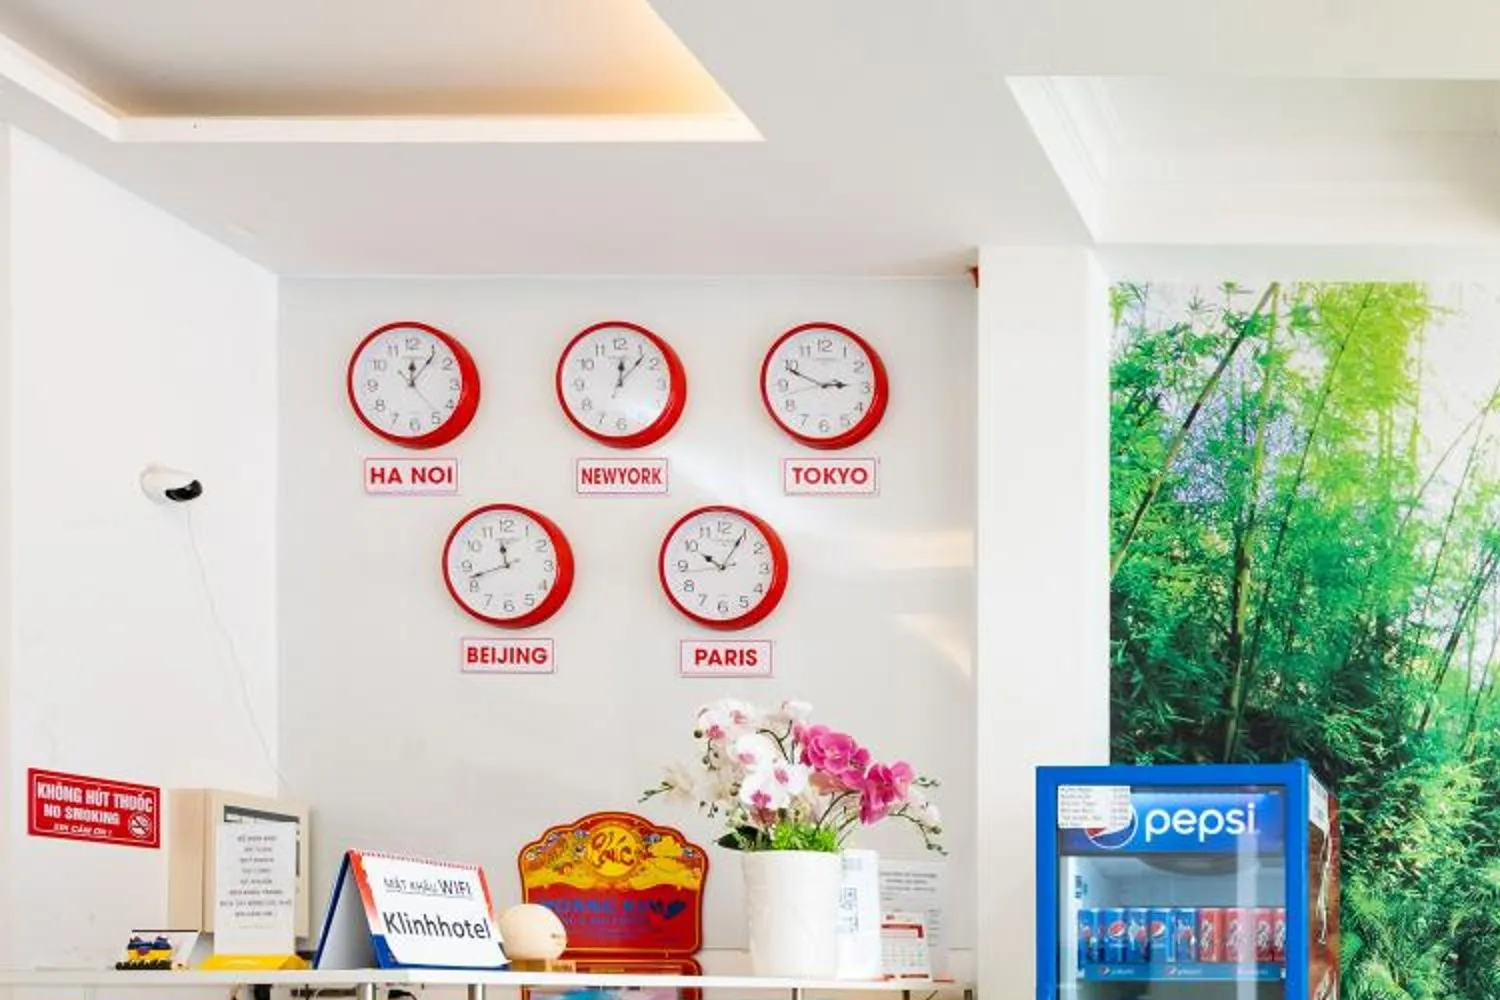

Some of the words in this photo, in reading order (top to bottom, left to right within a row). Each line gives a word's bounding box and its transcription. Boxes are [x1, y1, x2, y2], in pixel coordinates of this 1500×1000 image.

[404, 338, 421, 350] 12
[594, 344, 606, 356] 11
[613, 338, 628, 350] 12
[817, 339, 833, 352] 12
[388, 345, 400, 357] 11
[800, 345, 812, 358] 11
[373, 360, 387, 371] 10
[442, 358, 453, 370] 2
[580, 358, 595, 371] 10
[648, 358, 660, 370] 2
[853, 360, 865, 373] 2
[367, 379, 378, 392] 9
[449, 379, 460, 392] 3
[573, 379, 585, 392] 9
[778, 379, 789, 392] 9
[862, 382, 871, 394] 3
[374, 399, 385, 412] 8
[581, 398, 593, 411] 8
[784, 400, 796, 412] 8
[854, 402, 864, 413] 4
[389, 413, 399, 426] 7
[431, 412, 441, 424] 5
[616, 418, 628, 431] 6
[799, 414, 810, 426] 7
[840, 414, 851, 426] 5
[409, 419, 421, 432] 6
[818, 420, 830, 433] 6
[370, 466, 402, 484] HA
[411, 466, 453, 484] NOI
[581, 467, 663, 485] NEWYORK
[792, 467, 868, 485] TOKYO
[482, 526, 494, 538] 11
[499, 520, 514, 532] 12
[699, 526, 712, 538] 11
[717, 521, 733, 534] 12
[467, 540, 483, 553] 10
[535, 540, 548, 552] 2
[684, 540, 699, 553] 10
[753, 541, 765, 555] 2
[461, 560, 472, 573] 9
[544, 560, 554, 572] 3
[677, 560, 689, 573] 9
[758, 562, 770, 575] 3
[469, 580, 480, 593] 8
[683, 580, 695, 592] 8
[753, 583, 764, 594] 4
[483, 594, 494, 608] 7
[503, 600, 515, 612] 6
[524, 594, 535, 606] 5
[698, 594, 708, 607] 7
[738, 596, 750, 609] 5
[717, 600, 729, 614] 6
[467, 647, 548, 665] BEIJING
[694, 648, 758, 667] PARIS
[85, 787, 110, 807] HÚT
[43, 803, 61, 819] NO
[64, 806, 120, 825] SMOKING
[1145, 801, 1255, 843] pepsi
[438, 879, 472, 895] WIFI
[383, 911, 492, 939] Klinhhotel
